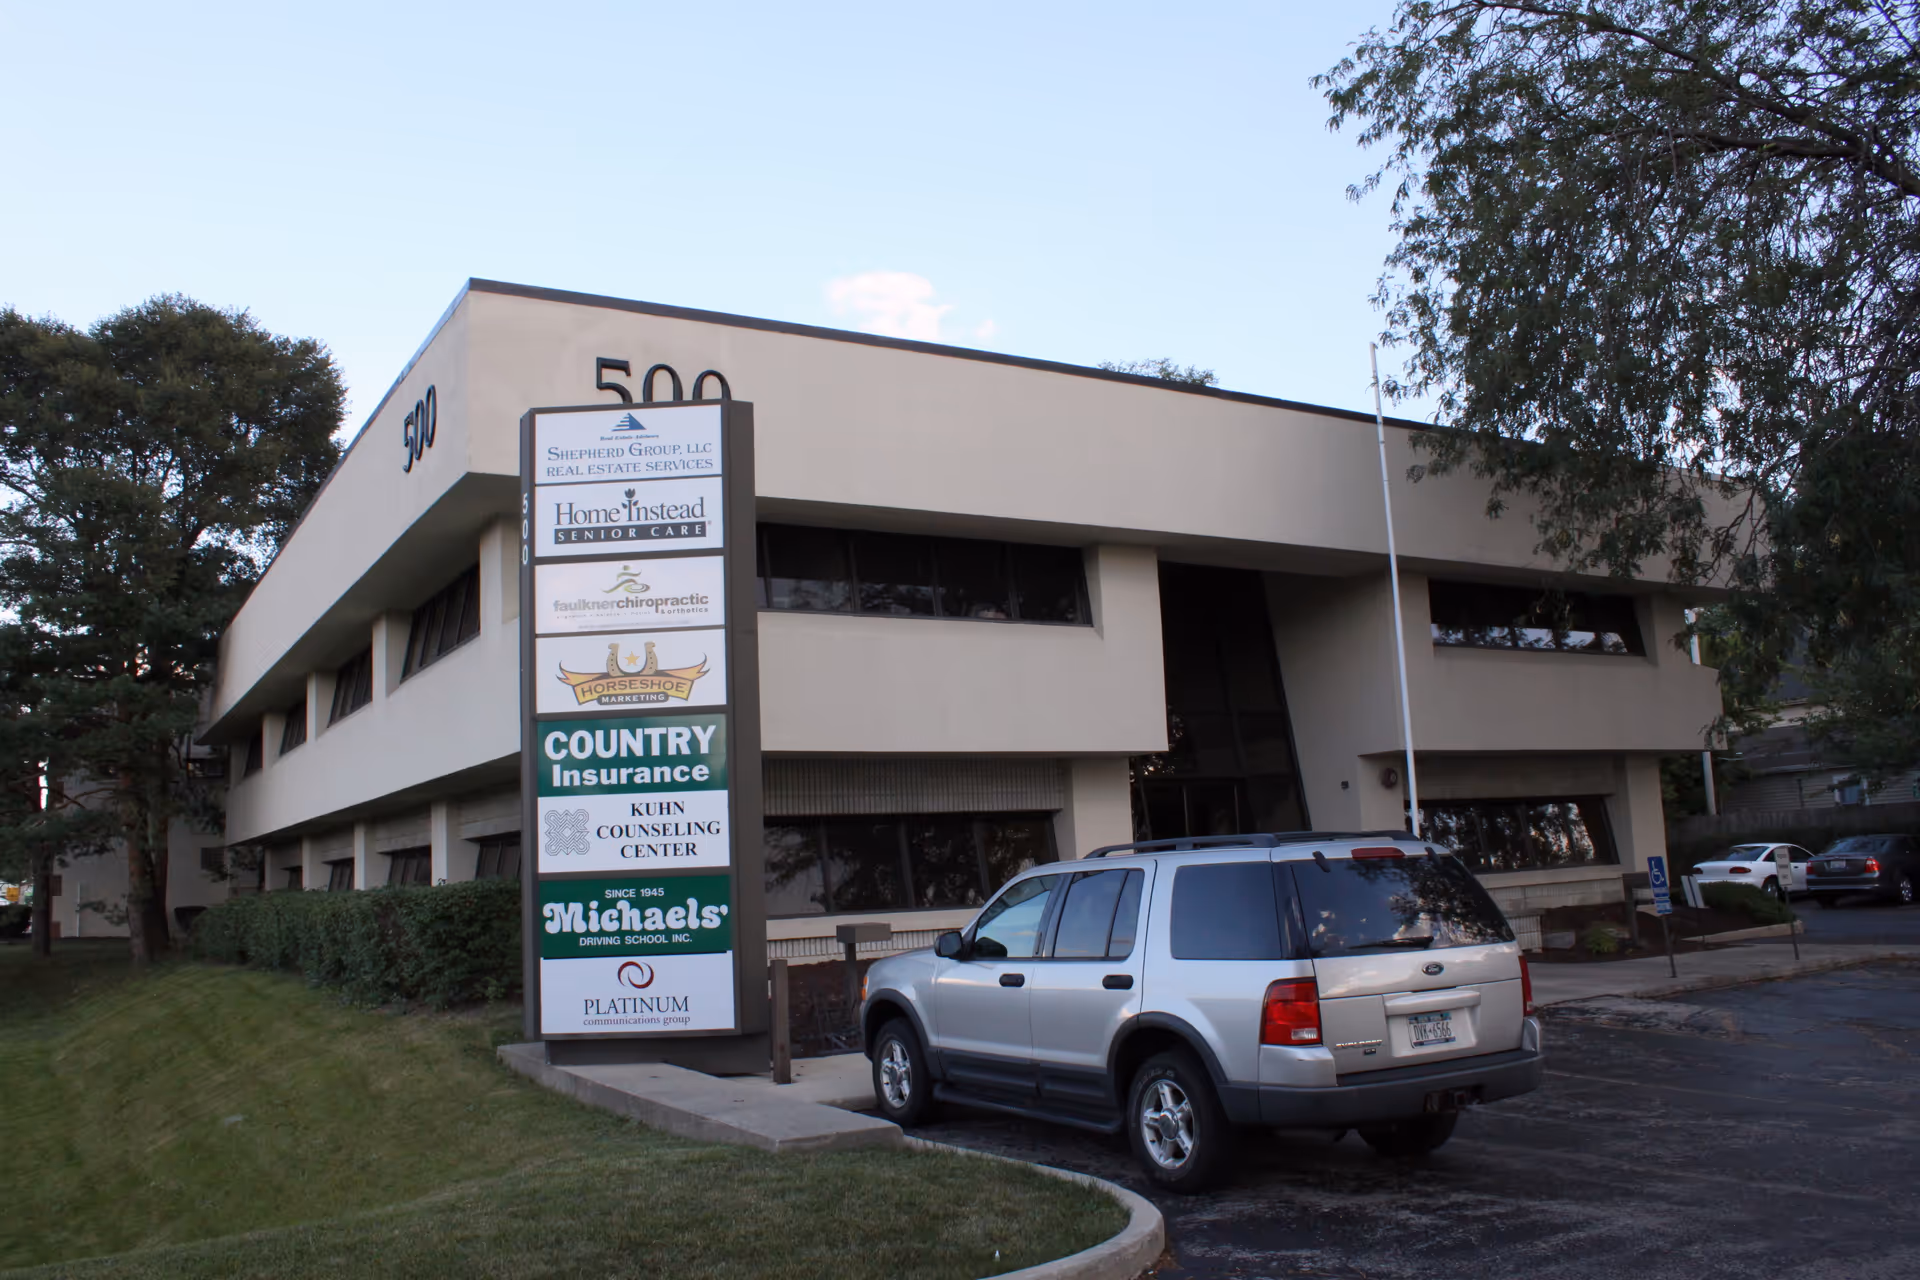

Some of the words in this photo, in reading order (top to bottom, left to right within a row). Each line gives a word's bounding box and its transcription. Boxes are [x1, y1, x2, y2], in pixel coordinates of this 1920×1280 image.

[403, 384, 437, 473] 500
[547, 446, 625, 461] SHEPHERD
[629, 442, 682, 457] GROUP,
[687, 443, 712, 454] LLC
[547, 465, 584, 477] REAL
[588, 462, 641, 475] ESTATE
[645, 458, 713, 473] SERVICES
[554, 502, 621, 525] Home
[626, 496, 705, 522] Instead
[557, 527, 637, 542] SENIOR
[650, 525, 703, 537] CARE
[553, 593, 709, 614] faulknerchiropractic
[667, 606, 709, 615] orthotics
[581, 679, 687, 698] HORSESHOE
[601, 693, 666, 704] MARKETING
[544, 724, 717, 760] COUNTRY
[552, 763, 710, 787] Insurance
[630, 800, 686, 817] KUHN
[596, 820, 721, 840] COUNSELING
[620, 842, 698, 859] CENTER
[605, 889, 636, 899] SINCE
[640, 887, 665, 898] 1945
[542, 897, 729, 935] Michaels'
[579, 936, 621, 947] DRIVING
[624, 934, 669, 945] SCHOOL
[672, 933, 693, 943] INC.
[584, 995, 690, 1016] PLATINUM
[583, 1015, 661, 1026] communications
[663, 1015, 691, 1027] group
